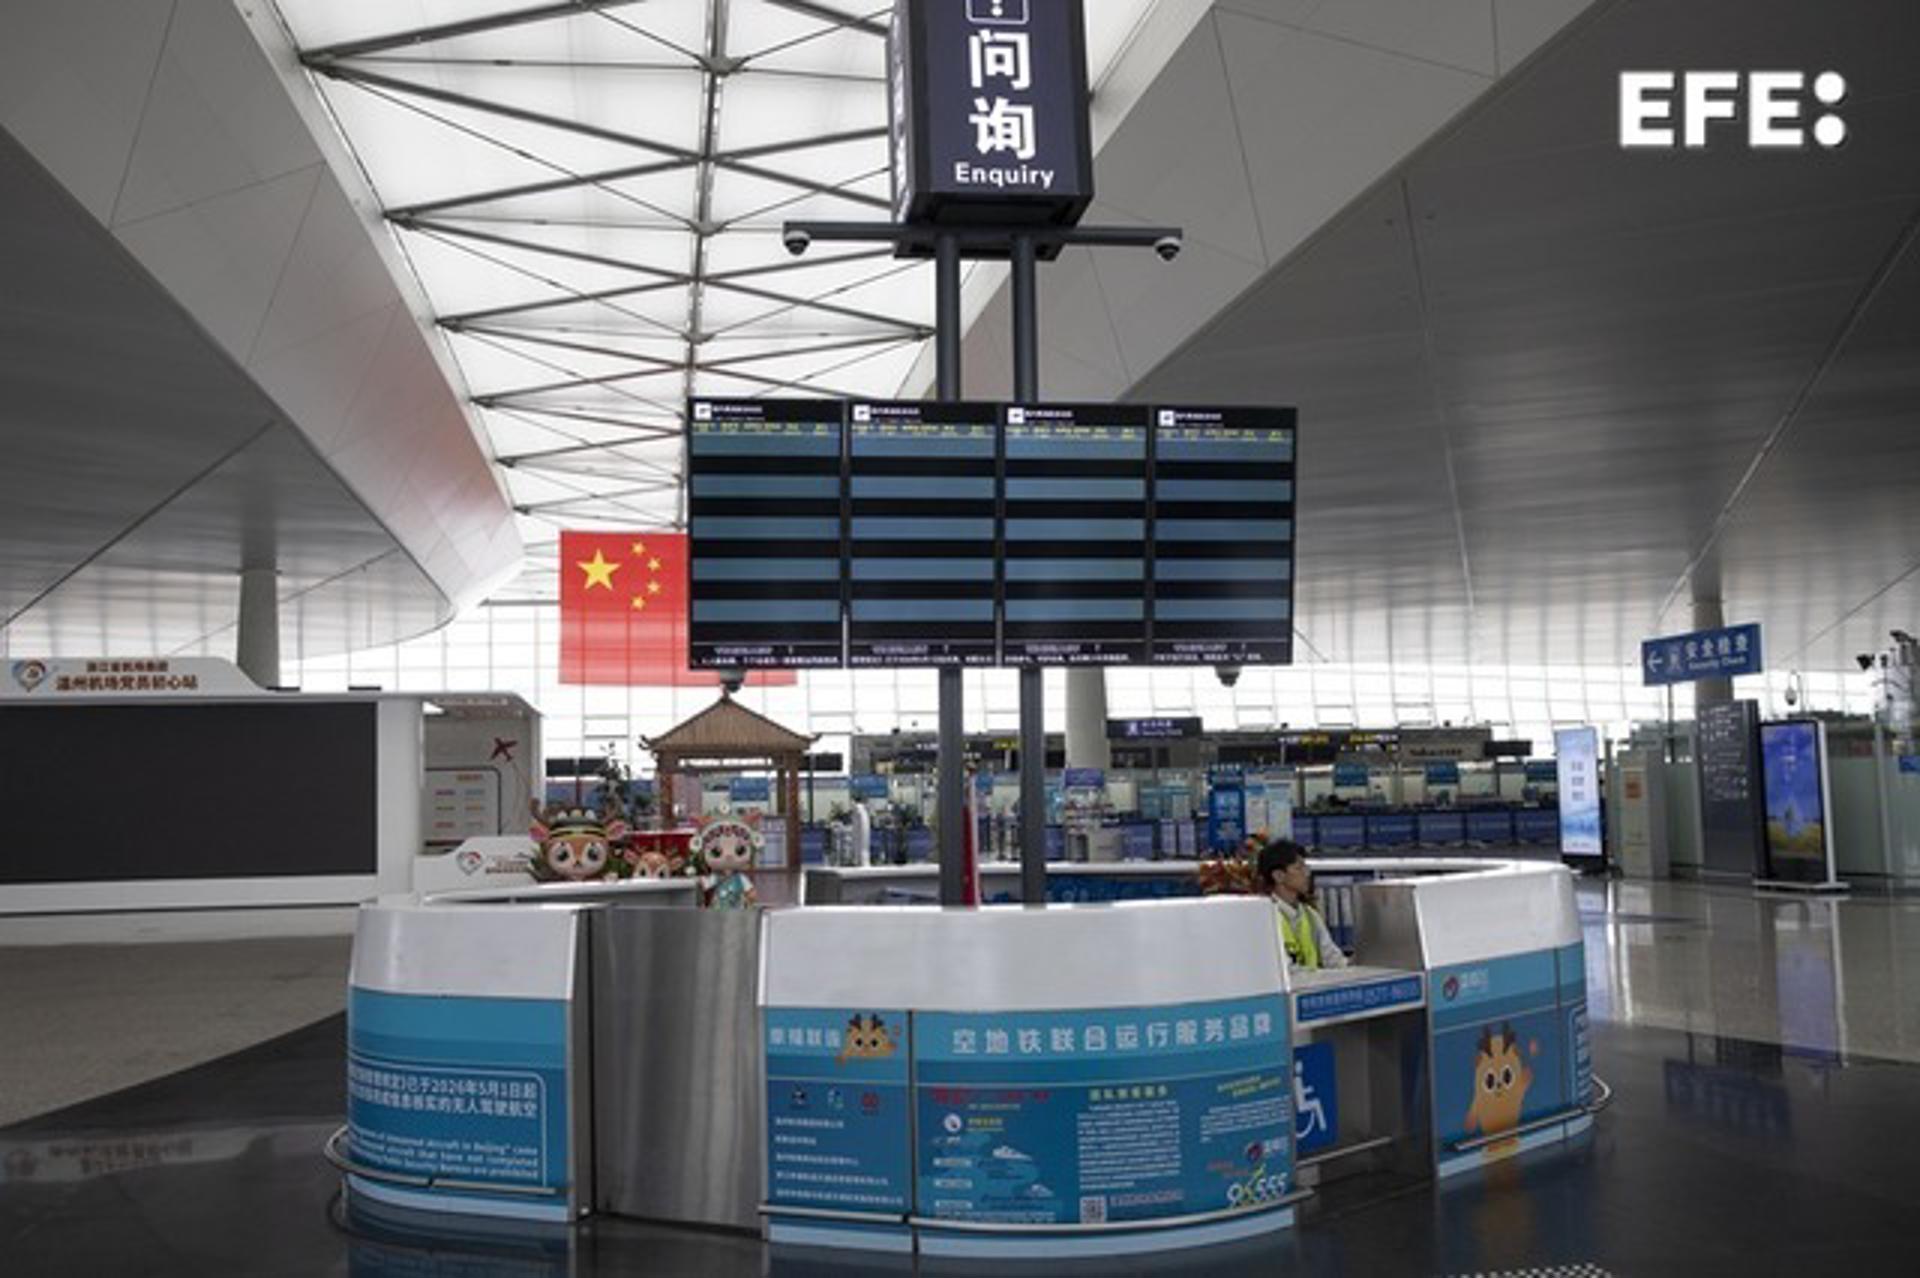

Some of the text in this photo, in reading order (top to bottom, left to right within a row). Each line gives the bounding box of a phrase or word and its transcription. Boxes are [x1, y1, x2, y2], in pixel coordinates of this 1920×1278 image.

[968, 29, 1036, 160] 问询
[955, 161, 1055, 190] Enquiry
[952, 1012, 1272, 1053] 空地铁联合运行服务品牌
